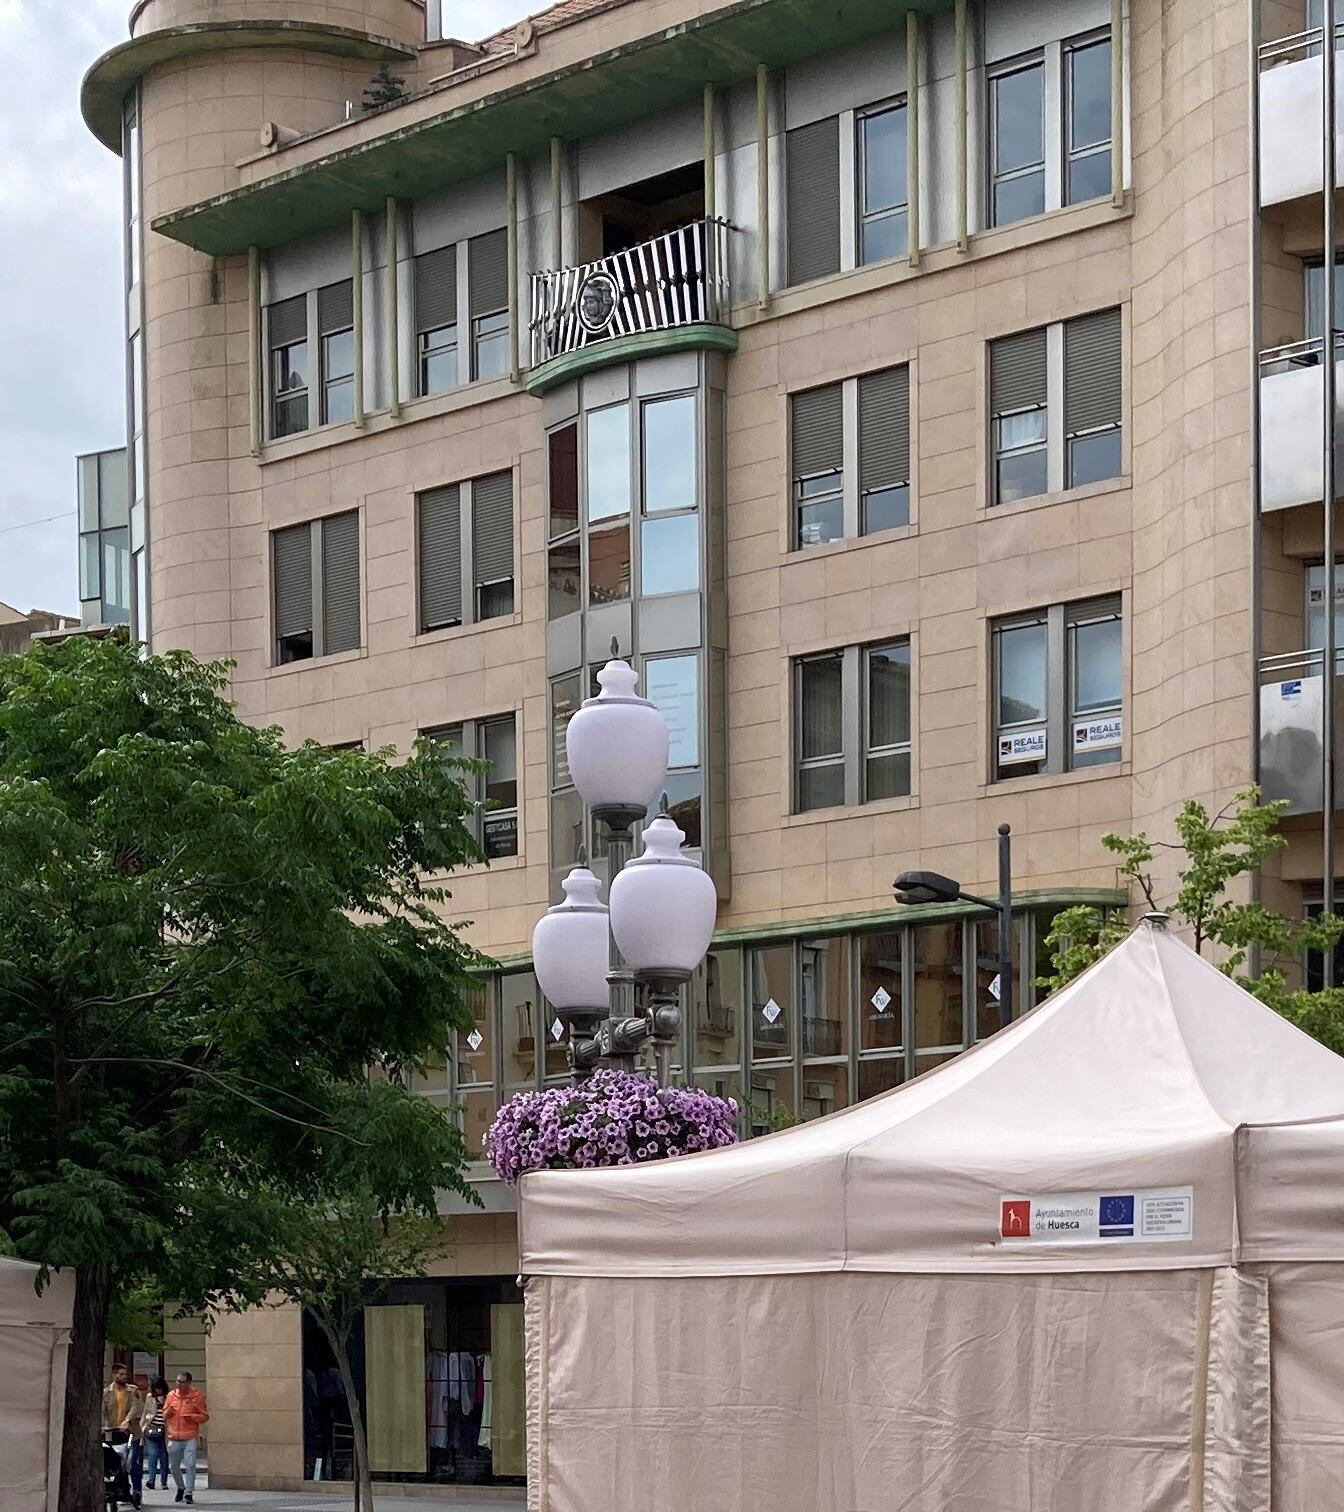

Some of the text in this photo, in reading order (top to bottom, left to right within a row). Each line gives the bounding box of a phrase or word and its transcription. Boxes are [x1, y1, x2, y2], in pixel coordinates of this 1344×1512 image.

[1089, 722, 1121, 734] REALE
[1013, 735, 1044, 747] REALE
[1035, 1208, 1094, 1219] Ayuntamiento
[1035, 1219, 1080, 1231] de Huesca
